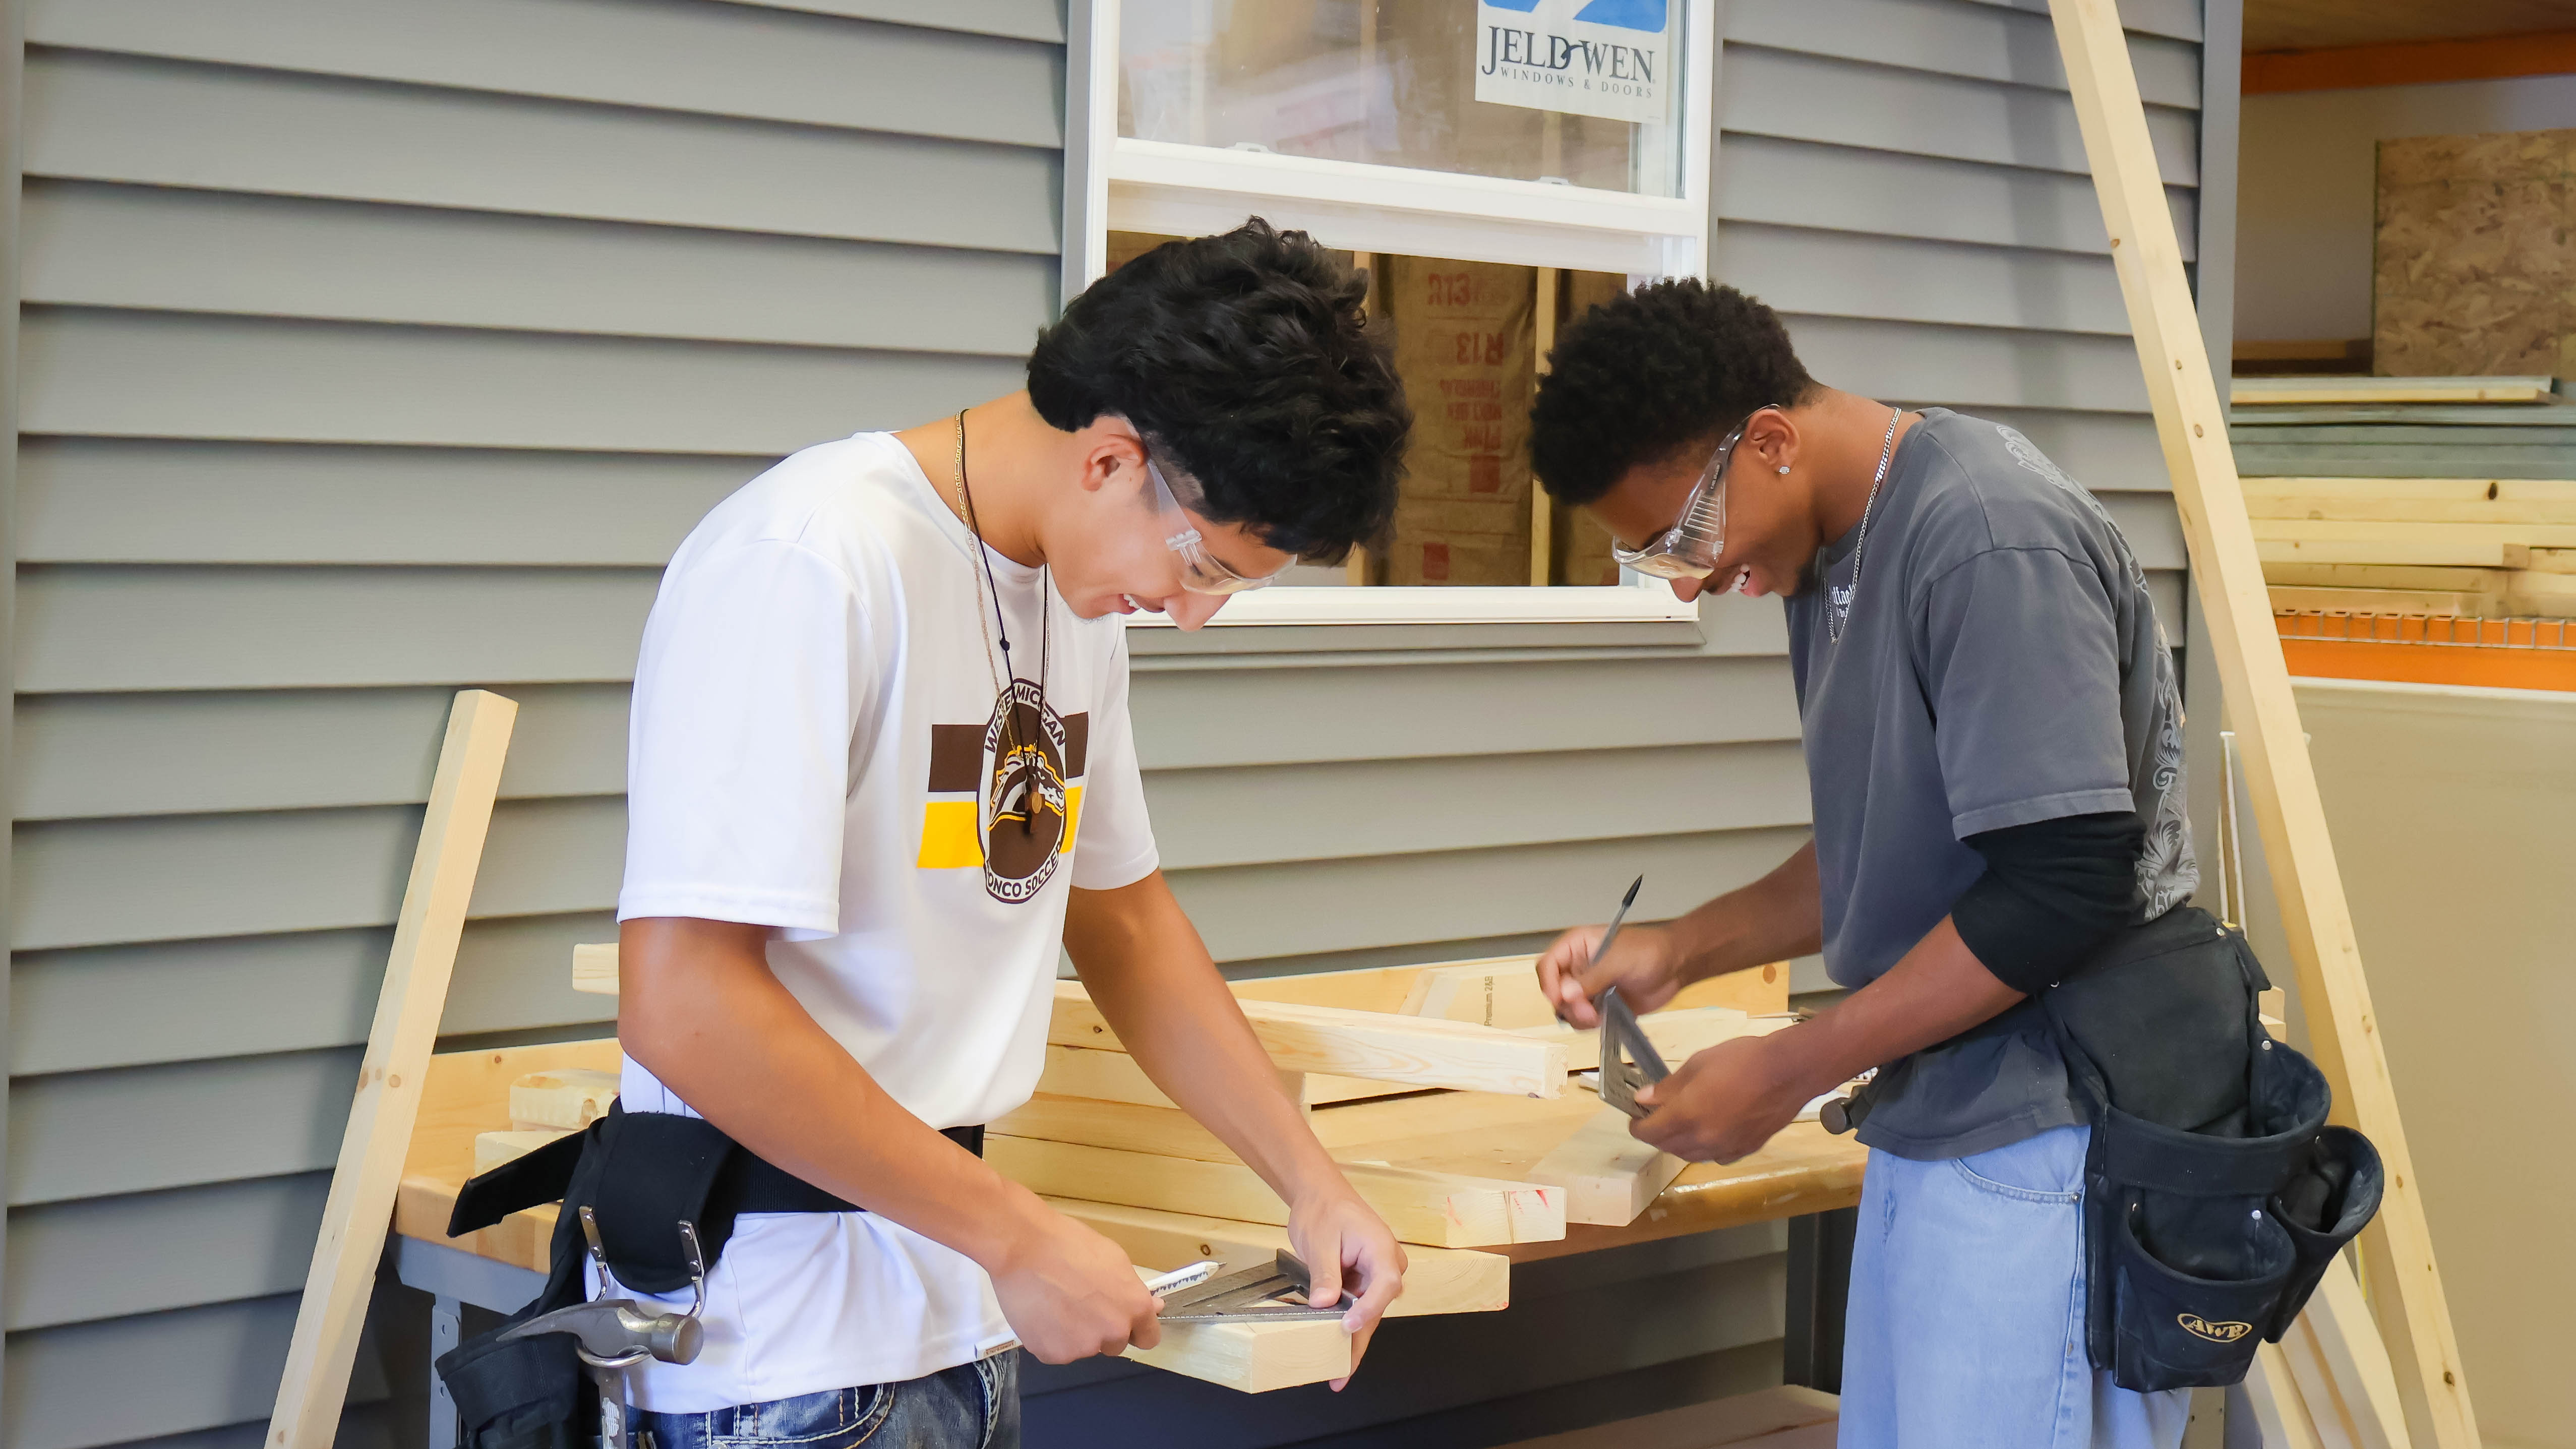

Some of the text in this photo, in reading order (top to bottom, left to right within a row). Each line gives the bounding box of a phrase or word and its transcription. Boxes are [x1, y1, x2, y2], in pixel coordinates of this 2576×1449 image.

[1501, 67, 1652, 98] WINDOWS & DOORS
[1015, 684, 1065, 746] MICGAN
